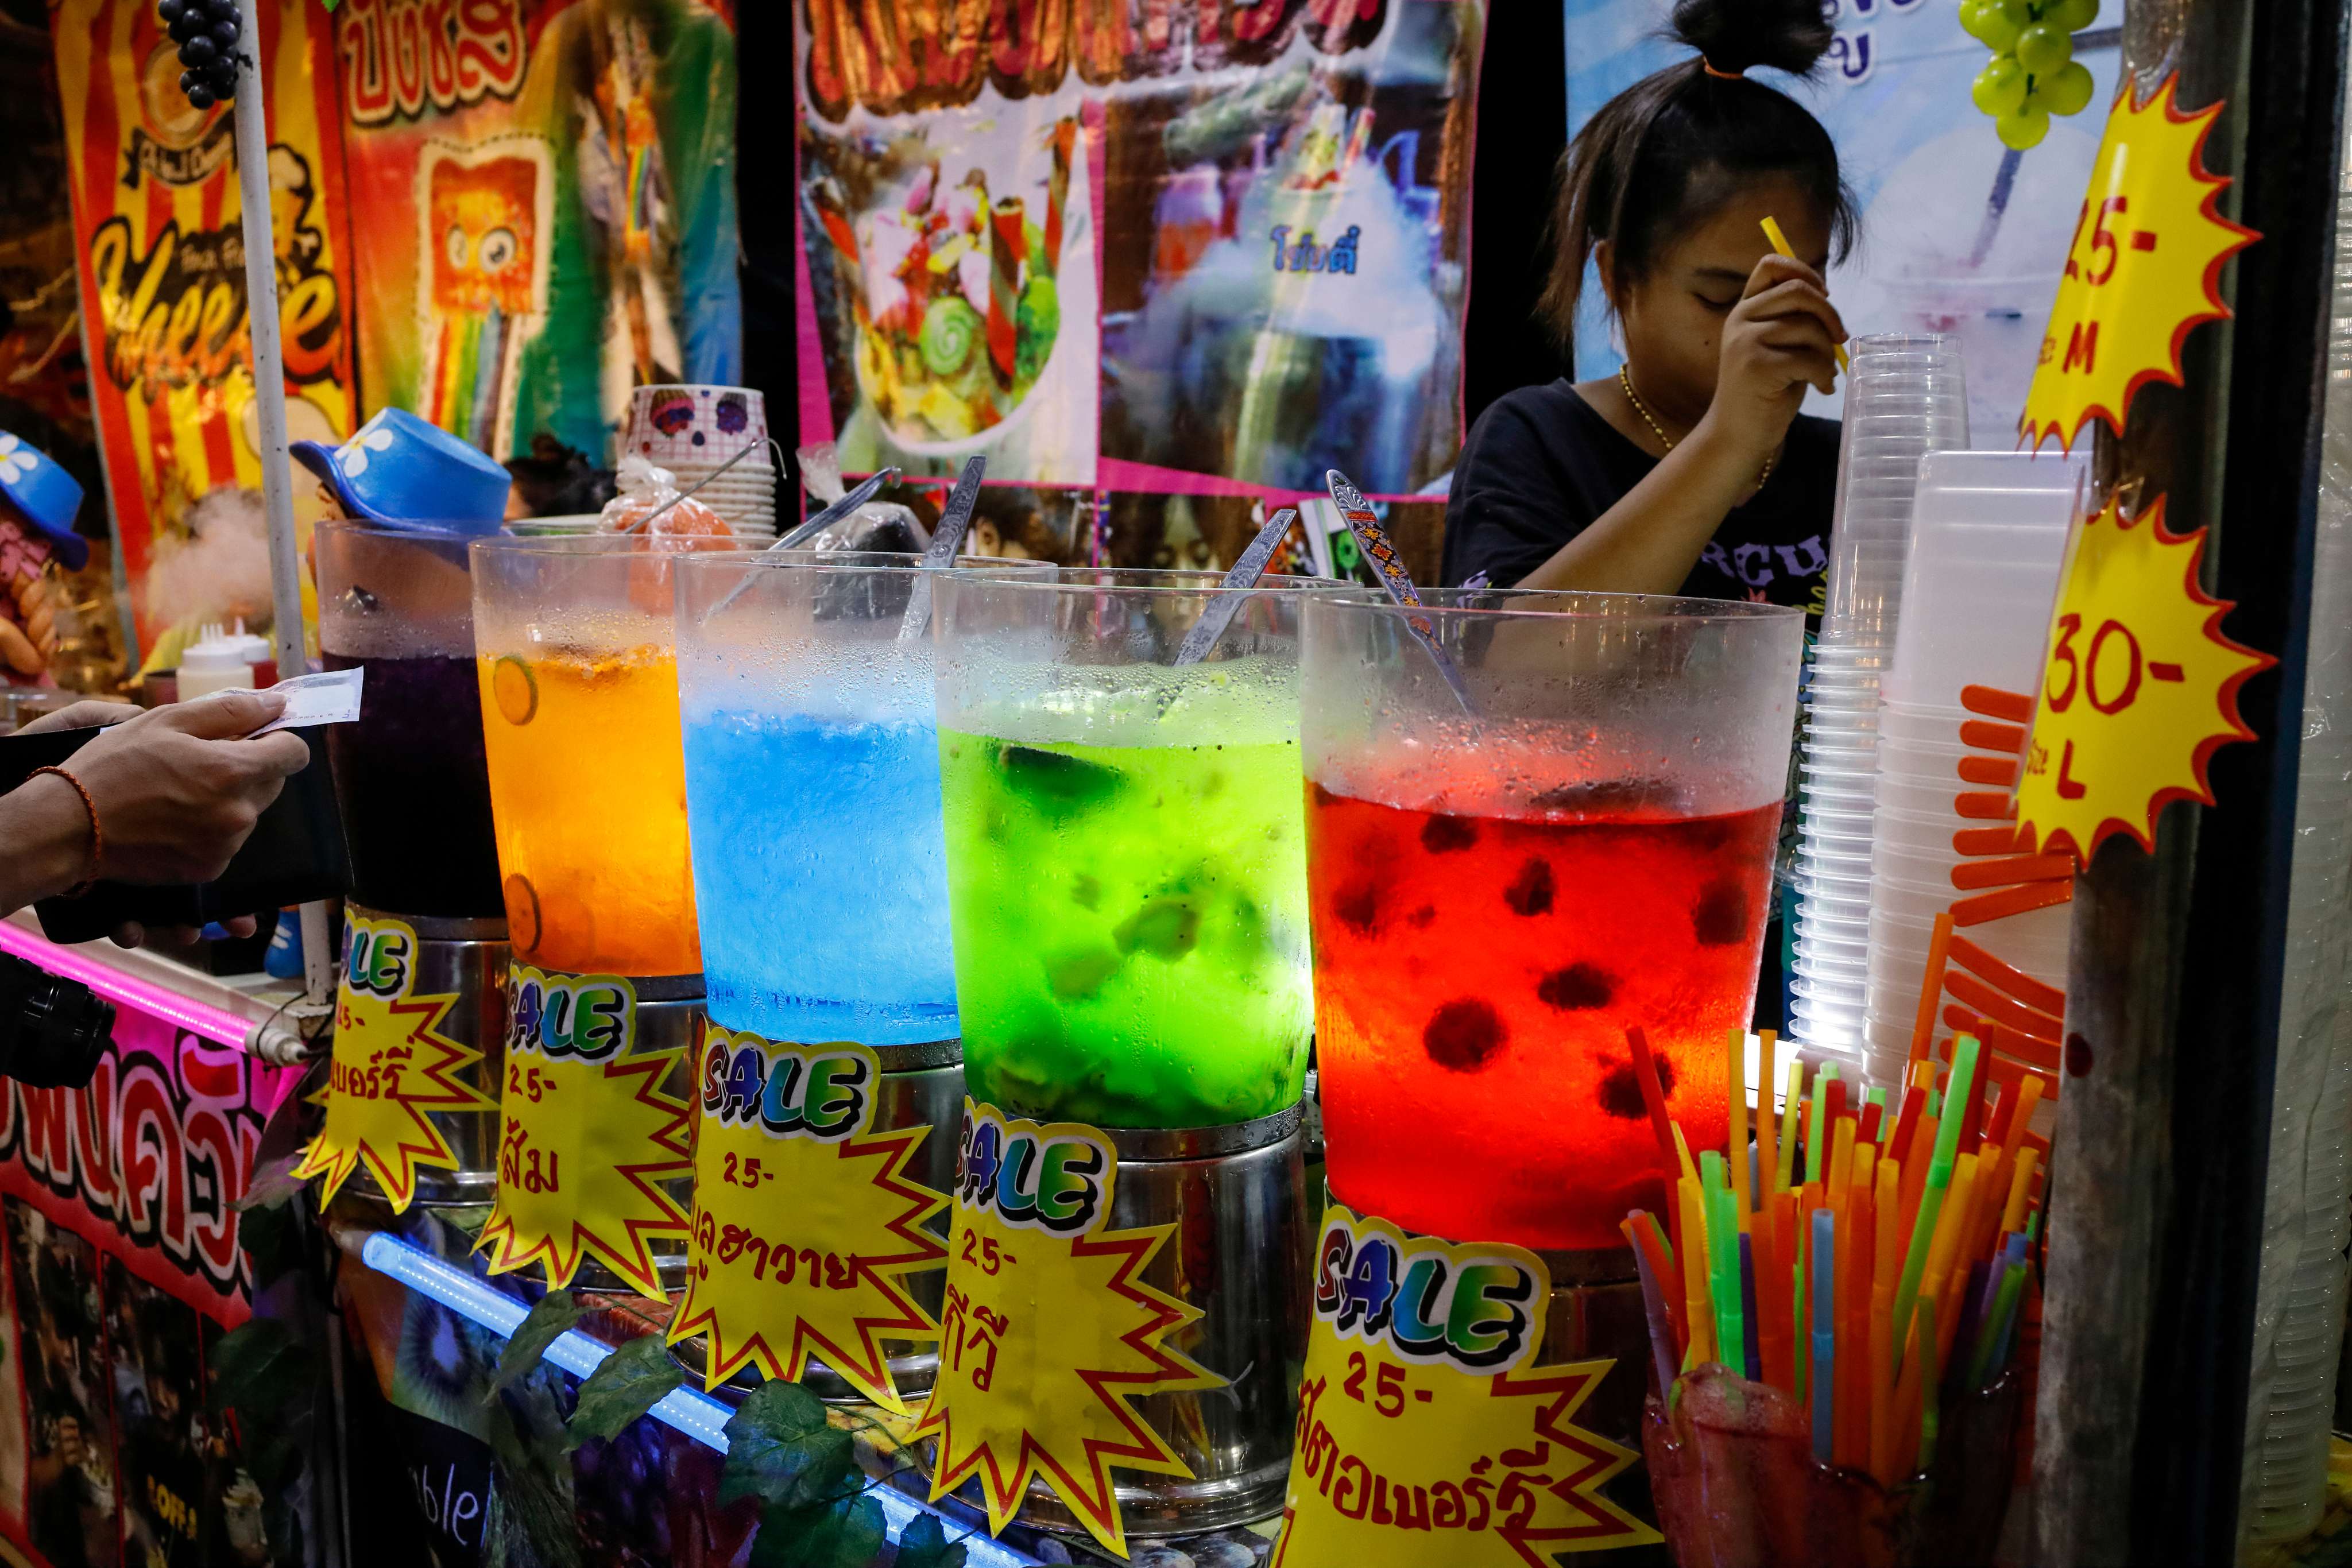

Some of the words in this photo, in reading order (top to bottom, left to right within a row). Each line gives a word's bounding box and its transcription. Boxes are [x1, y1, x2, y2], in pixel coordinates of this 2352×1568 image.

[1701, 534, 1829, 587] RCU
[2046, 613, 2185, 715] 30-
[2057, 738, 2087, 800] L
[509, 1063, 558, 1103] 25-
[703, 1043, 867, 1137] SALE
[502, 1116, 559, 1194] ส้ม
[723, 1152, 775, 1189] 25-
[961, 1228, 1016, 1276] 25-
[1316, 1229, 1532, 1367] SALE
[1343, 1351, 1433, 1418] 25-
